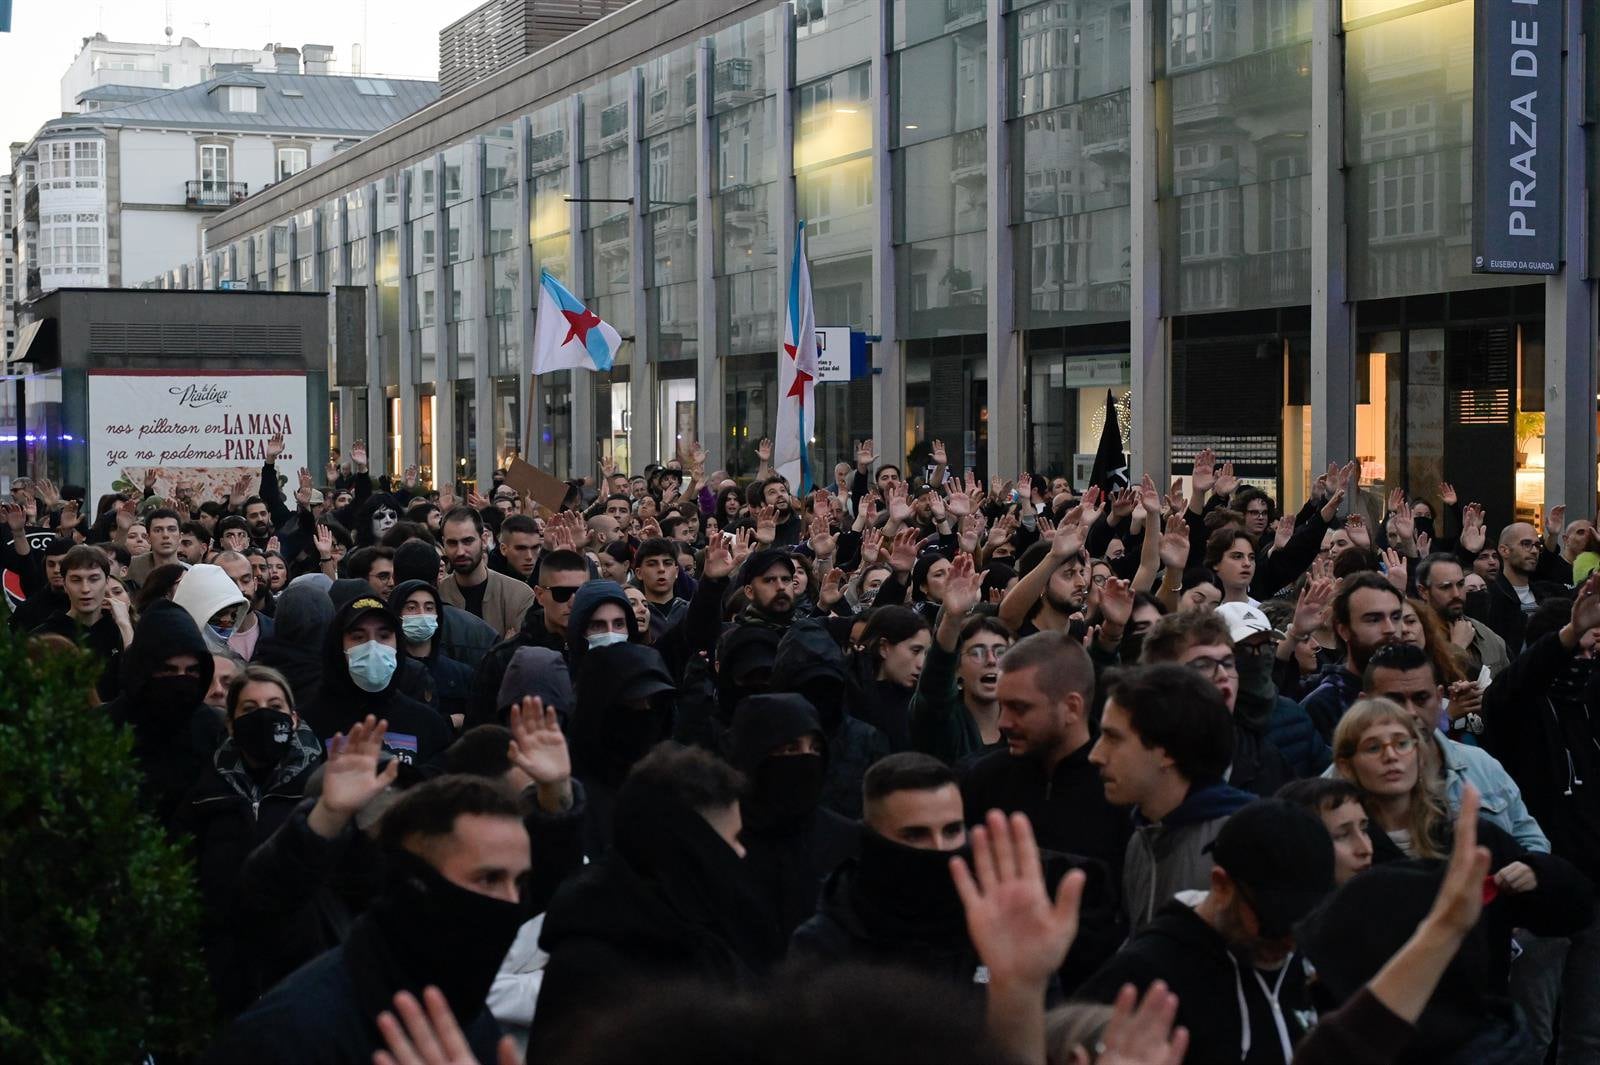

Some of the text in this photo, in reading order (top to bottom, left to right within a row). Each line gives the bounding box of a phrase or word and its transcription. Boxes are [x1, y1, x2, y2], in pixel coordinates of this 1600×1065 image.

[1511, 20, 1539, 77] DE
[1509, 91, 1537, 236] PRAZA
[1491, 260, 1518, 269] EUSEBIO
[1529, 263, 1554, 271] GUARDA
[169, 384, 227, 408] Piadina
[106, 414, 292, 439] nos pillaron en LA MASA
[107, 439, 292, 466] ya no podemos PARA...
